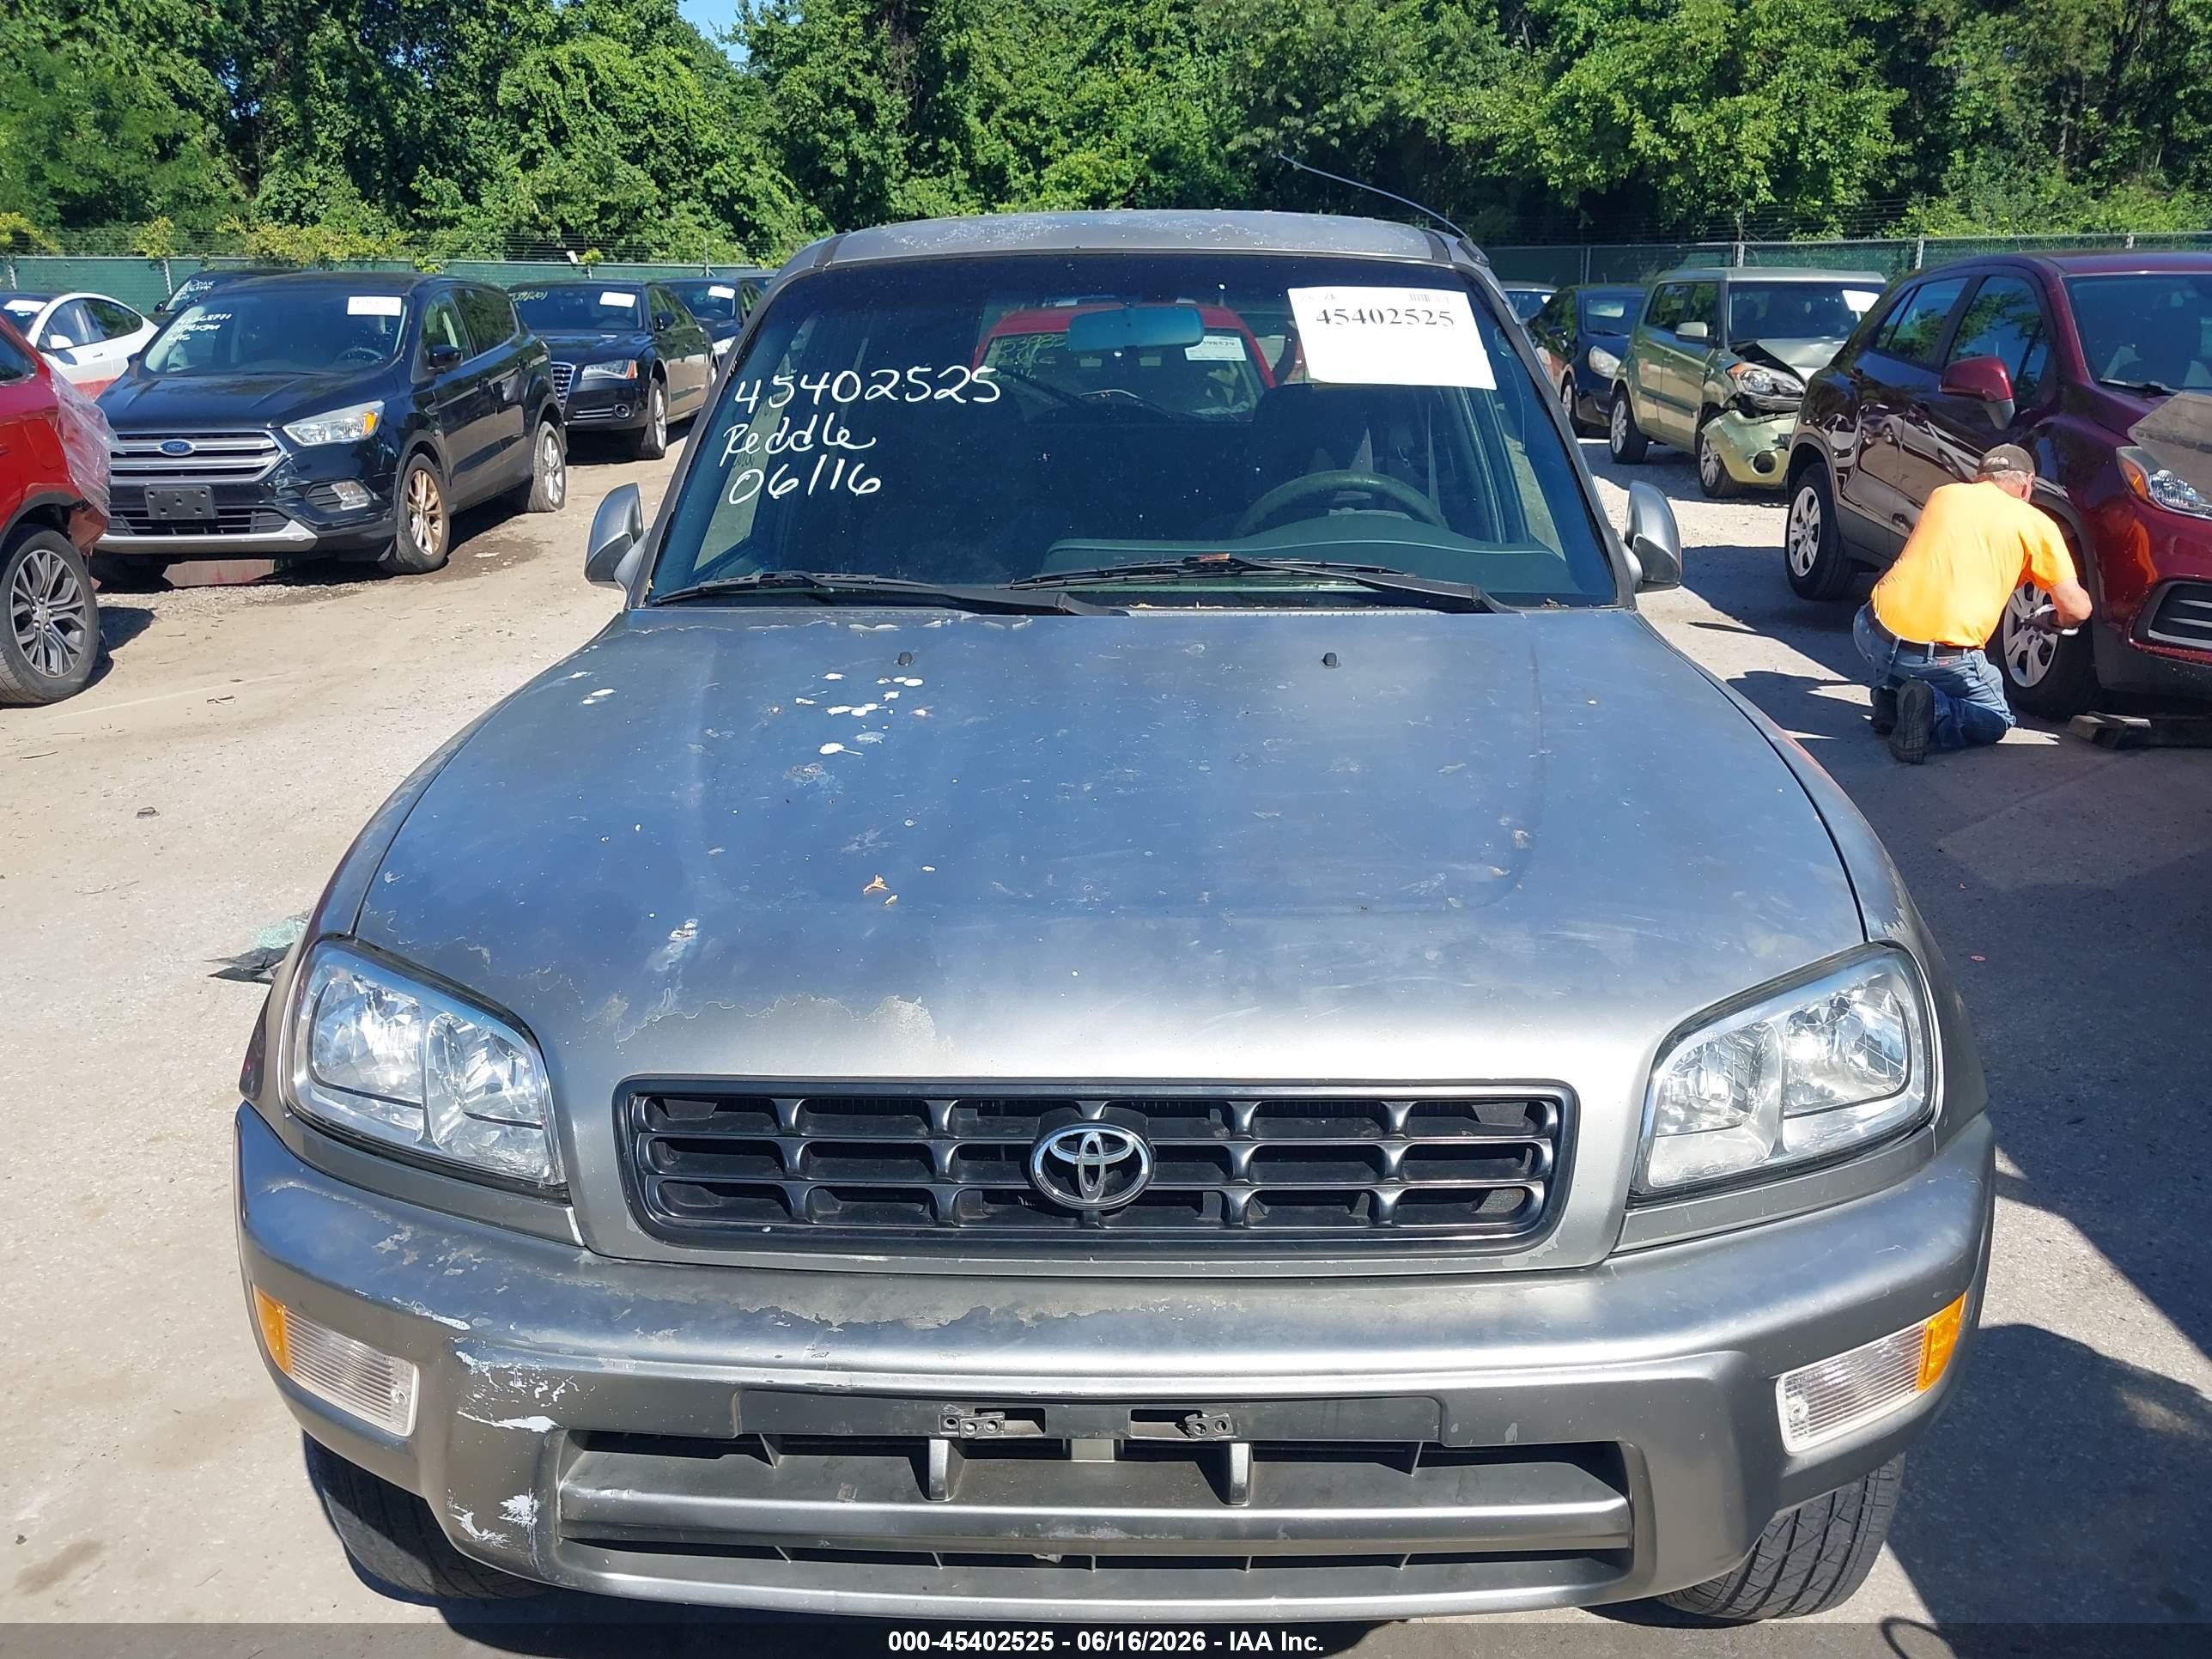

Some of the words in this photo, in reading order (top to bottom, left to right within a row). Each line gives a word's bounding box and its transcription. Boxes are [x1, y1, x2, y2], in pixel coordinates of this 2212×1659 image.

[1316, 307, 1455, 327] 45402525
[734, 365, 1002, 415] 45402525
[728, 454, 882, 505] 06/16
